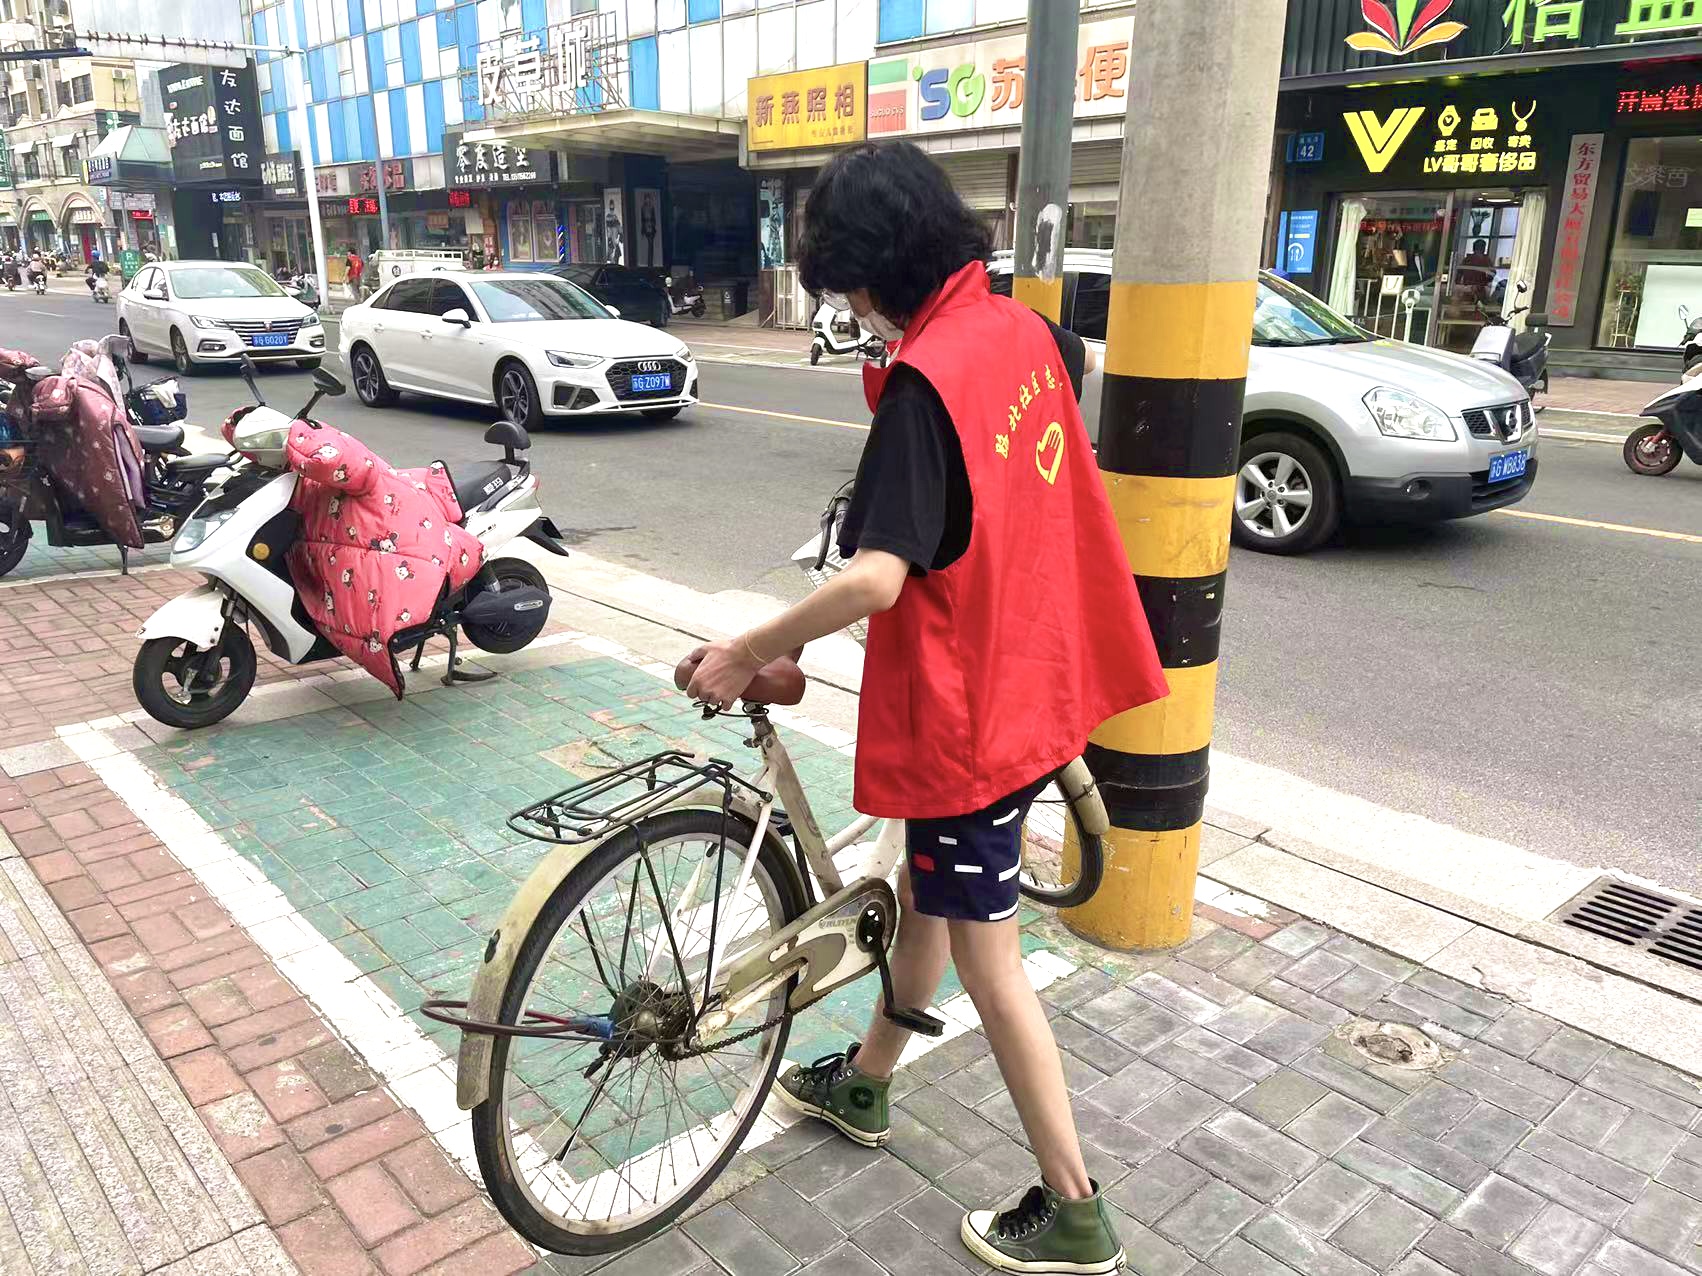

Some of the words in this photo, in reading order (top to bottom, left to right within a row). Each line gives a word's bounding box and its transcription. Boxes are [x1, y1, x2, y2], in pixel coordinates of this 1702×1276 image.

[991, 42, 1128, 112] 苏便
[219, 69, 249, 169] 友达面馆
[755, 83, 854, 127] 新燕照相
[1300, 144, 1315, 158] 42
[1470, 136, 1495, 150] 回收
[1507, 135, 1532, 149] 寄卖
[1423, 151, 1537, 174] LV哥哥奢侈品
